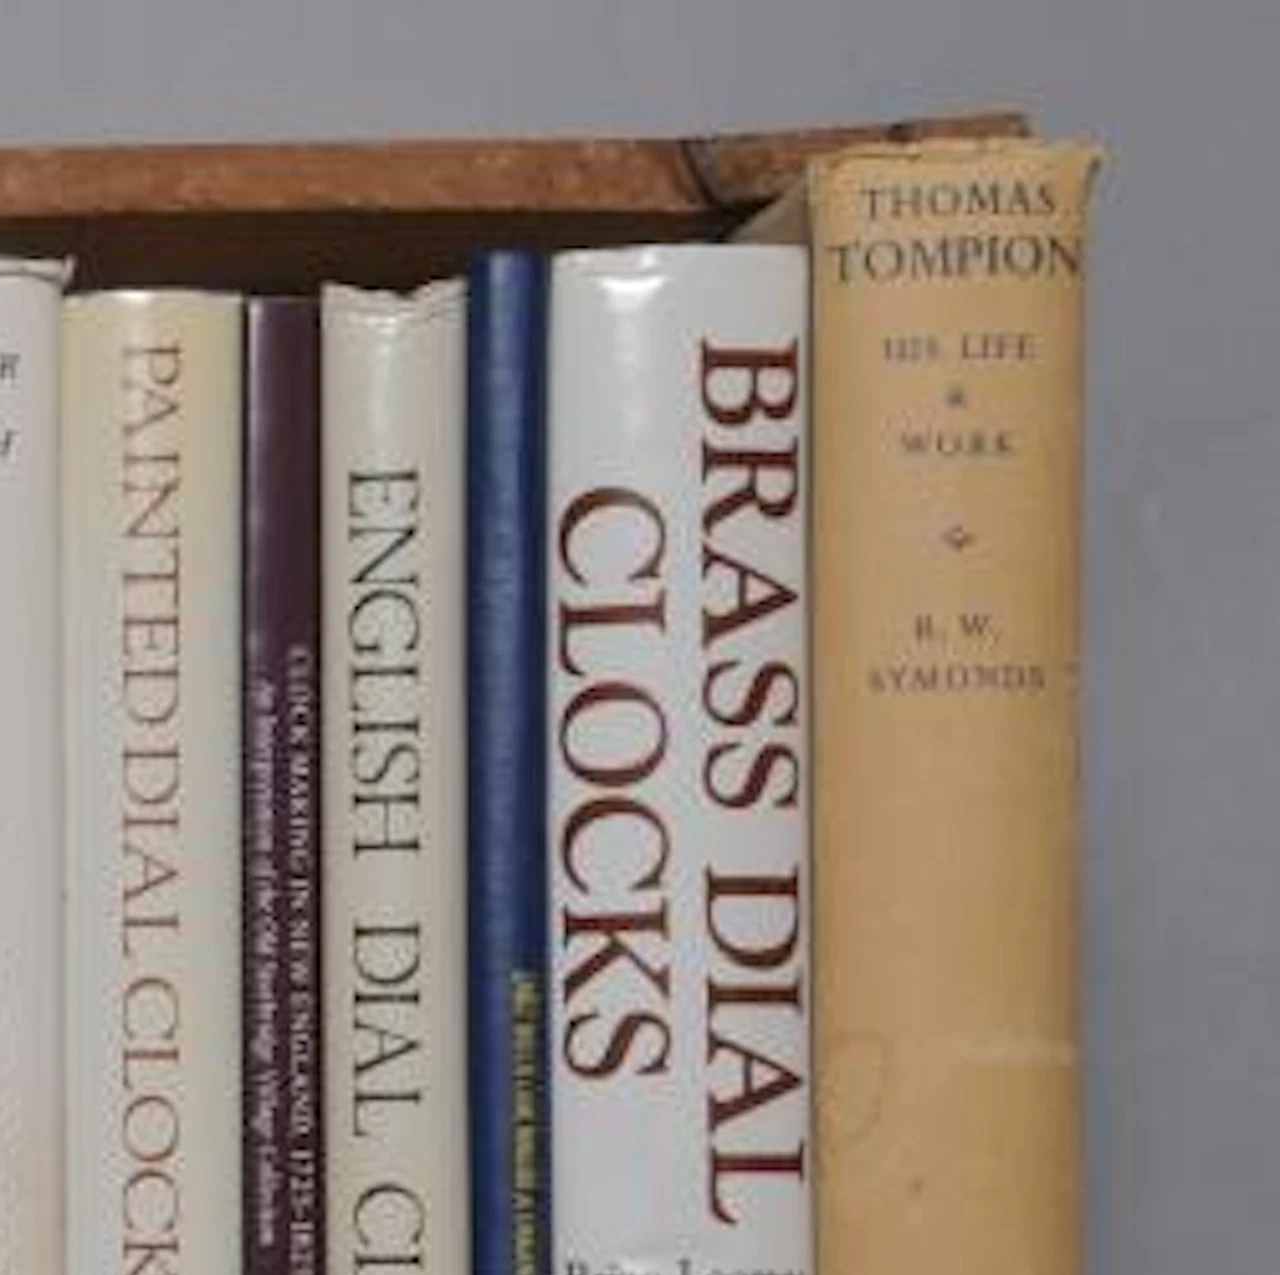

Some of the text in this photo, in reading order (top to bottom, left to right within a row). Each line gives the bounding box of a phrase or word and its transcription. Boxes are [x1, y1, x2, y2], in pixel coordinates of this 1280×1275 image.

[824, 233, 1082, 283] TOMPION
[860, 178, 1055, 221] THOMAS
[884, 332, 1039, 362] HIS LIFE
[899, 428, 1015, 456] WORK
[122, 344, 182, 729] PAINTED
[348, 469, 421, 858] ENGLISH
[867, 663, 1047, 694] SYMONDS
[122, 744, 182, 958] DIAL
[556, 485, 673, 1082] CLOCKS
[696, 337, 806, 1227] BRASS DIAL
[352, 921, 422, 1137] DIAL
